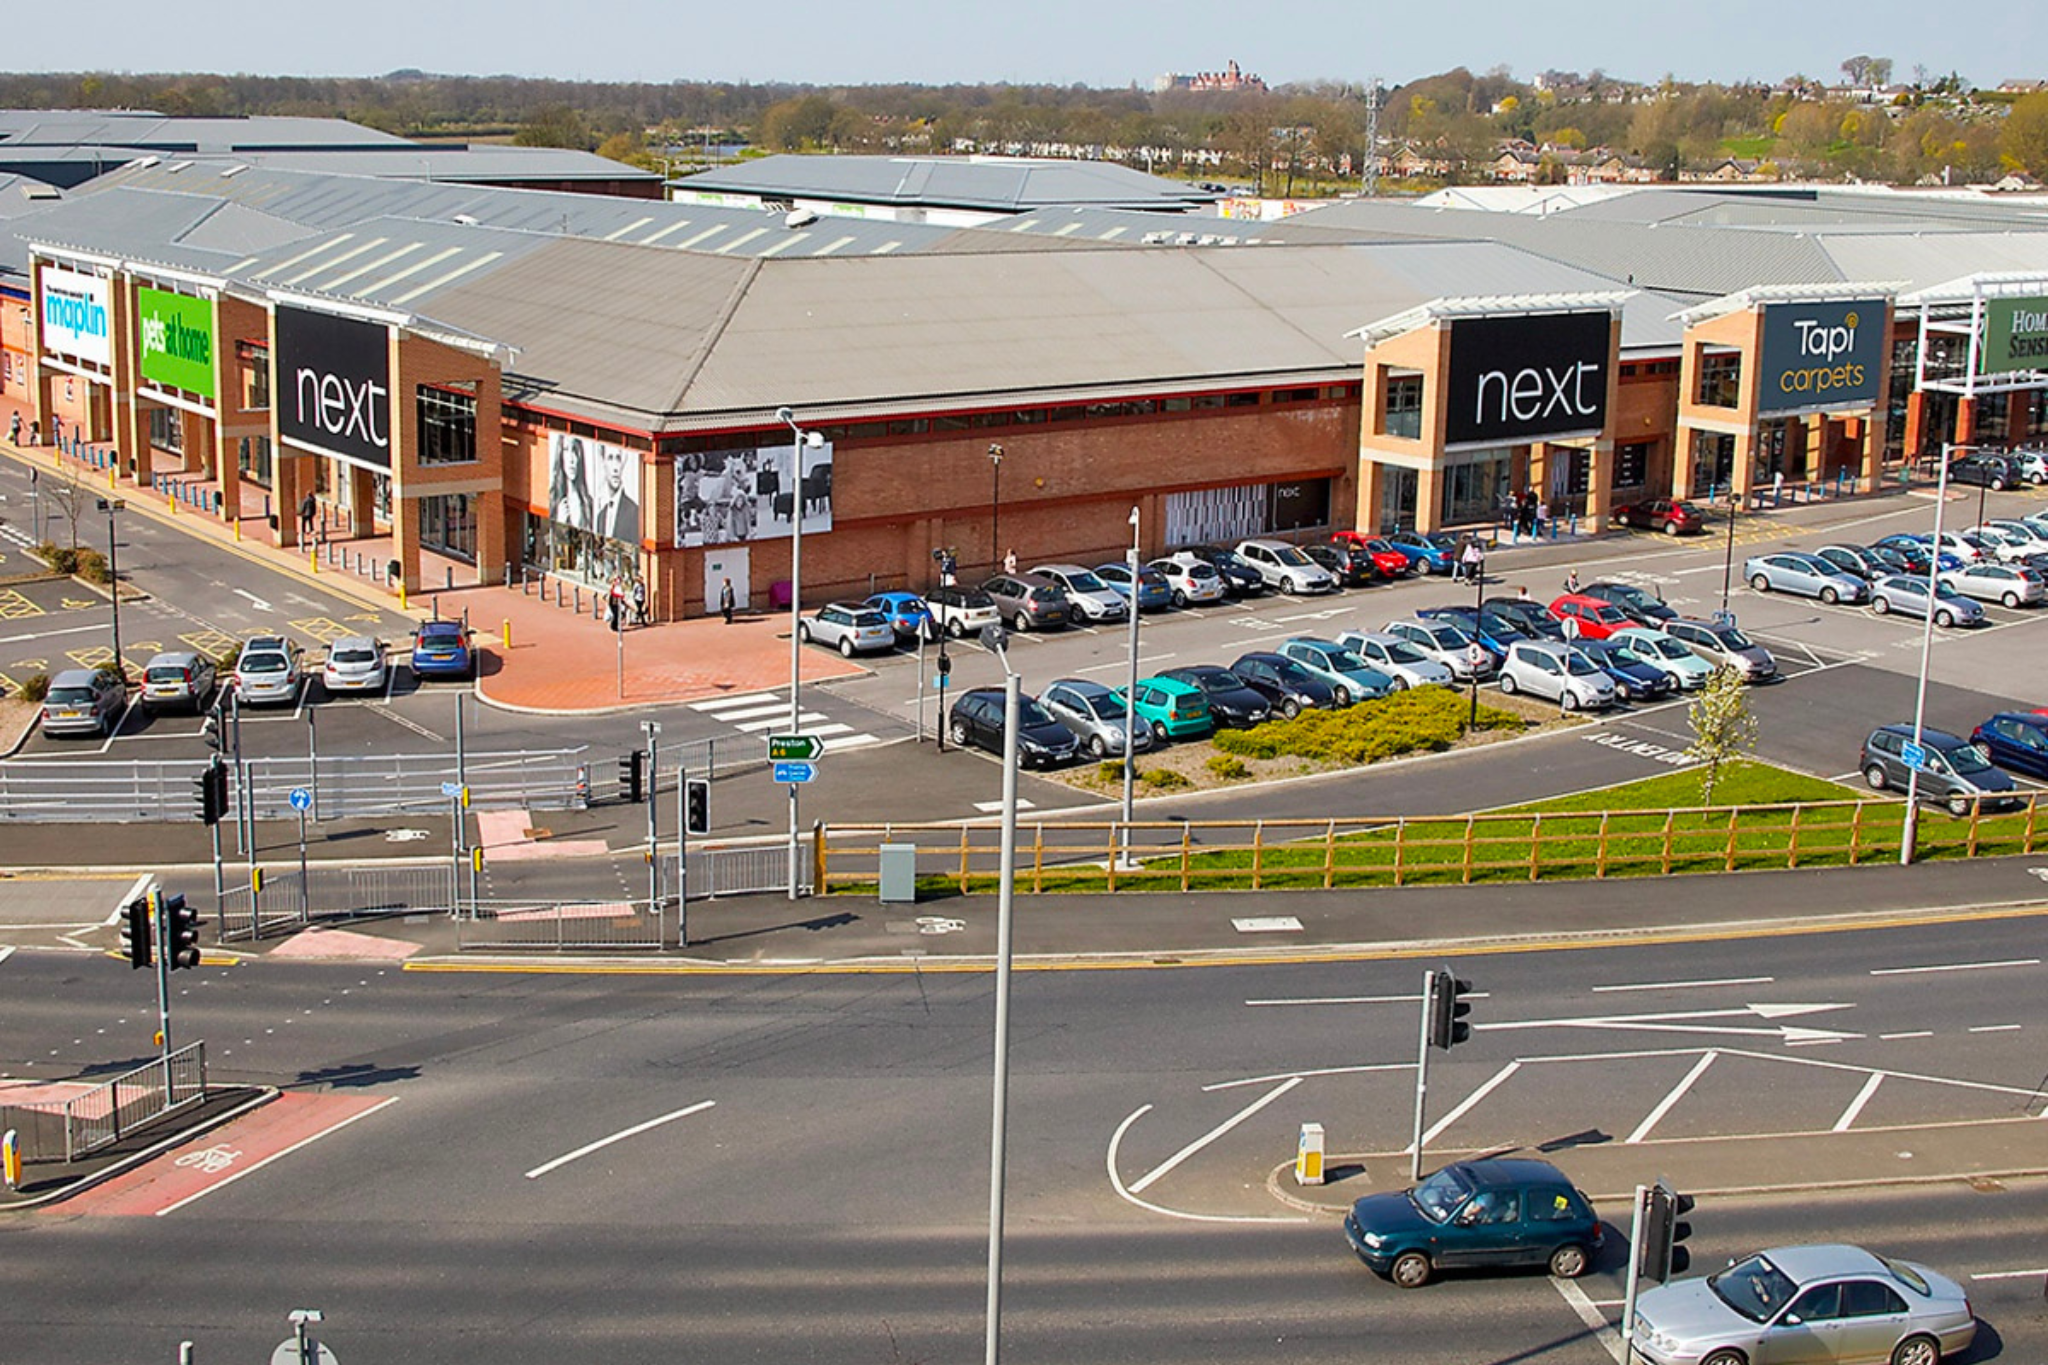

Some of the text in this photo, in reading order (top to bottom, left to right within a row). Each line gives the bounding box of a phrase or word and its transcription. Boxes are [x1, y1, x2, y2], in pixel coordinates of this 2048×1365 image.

[46, 292, 106, 339] maplin
[1793, 311, 1859, 363] Tapi
[1475, 360, 1599, 425] next
[1779, 361, 1866, 394] carpets
[297, 367, 388, 447] next
